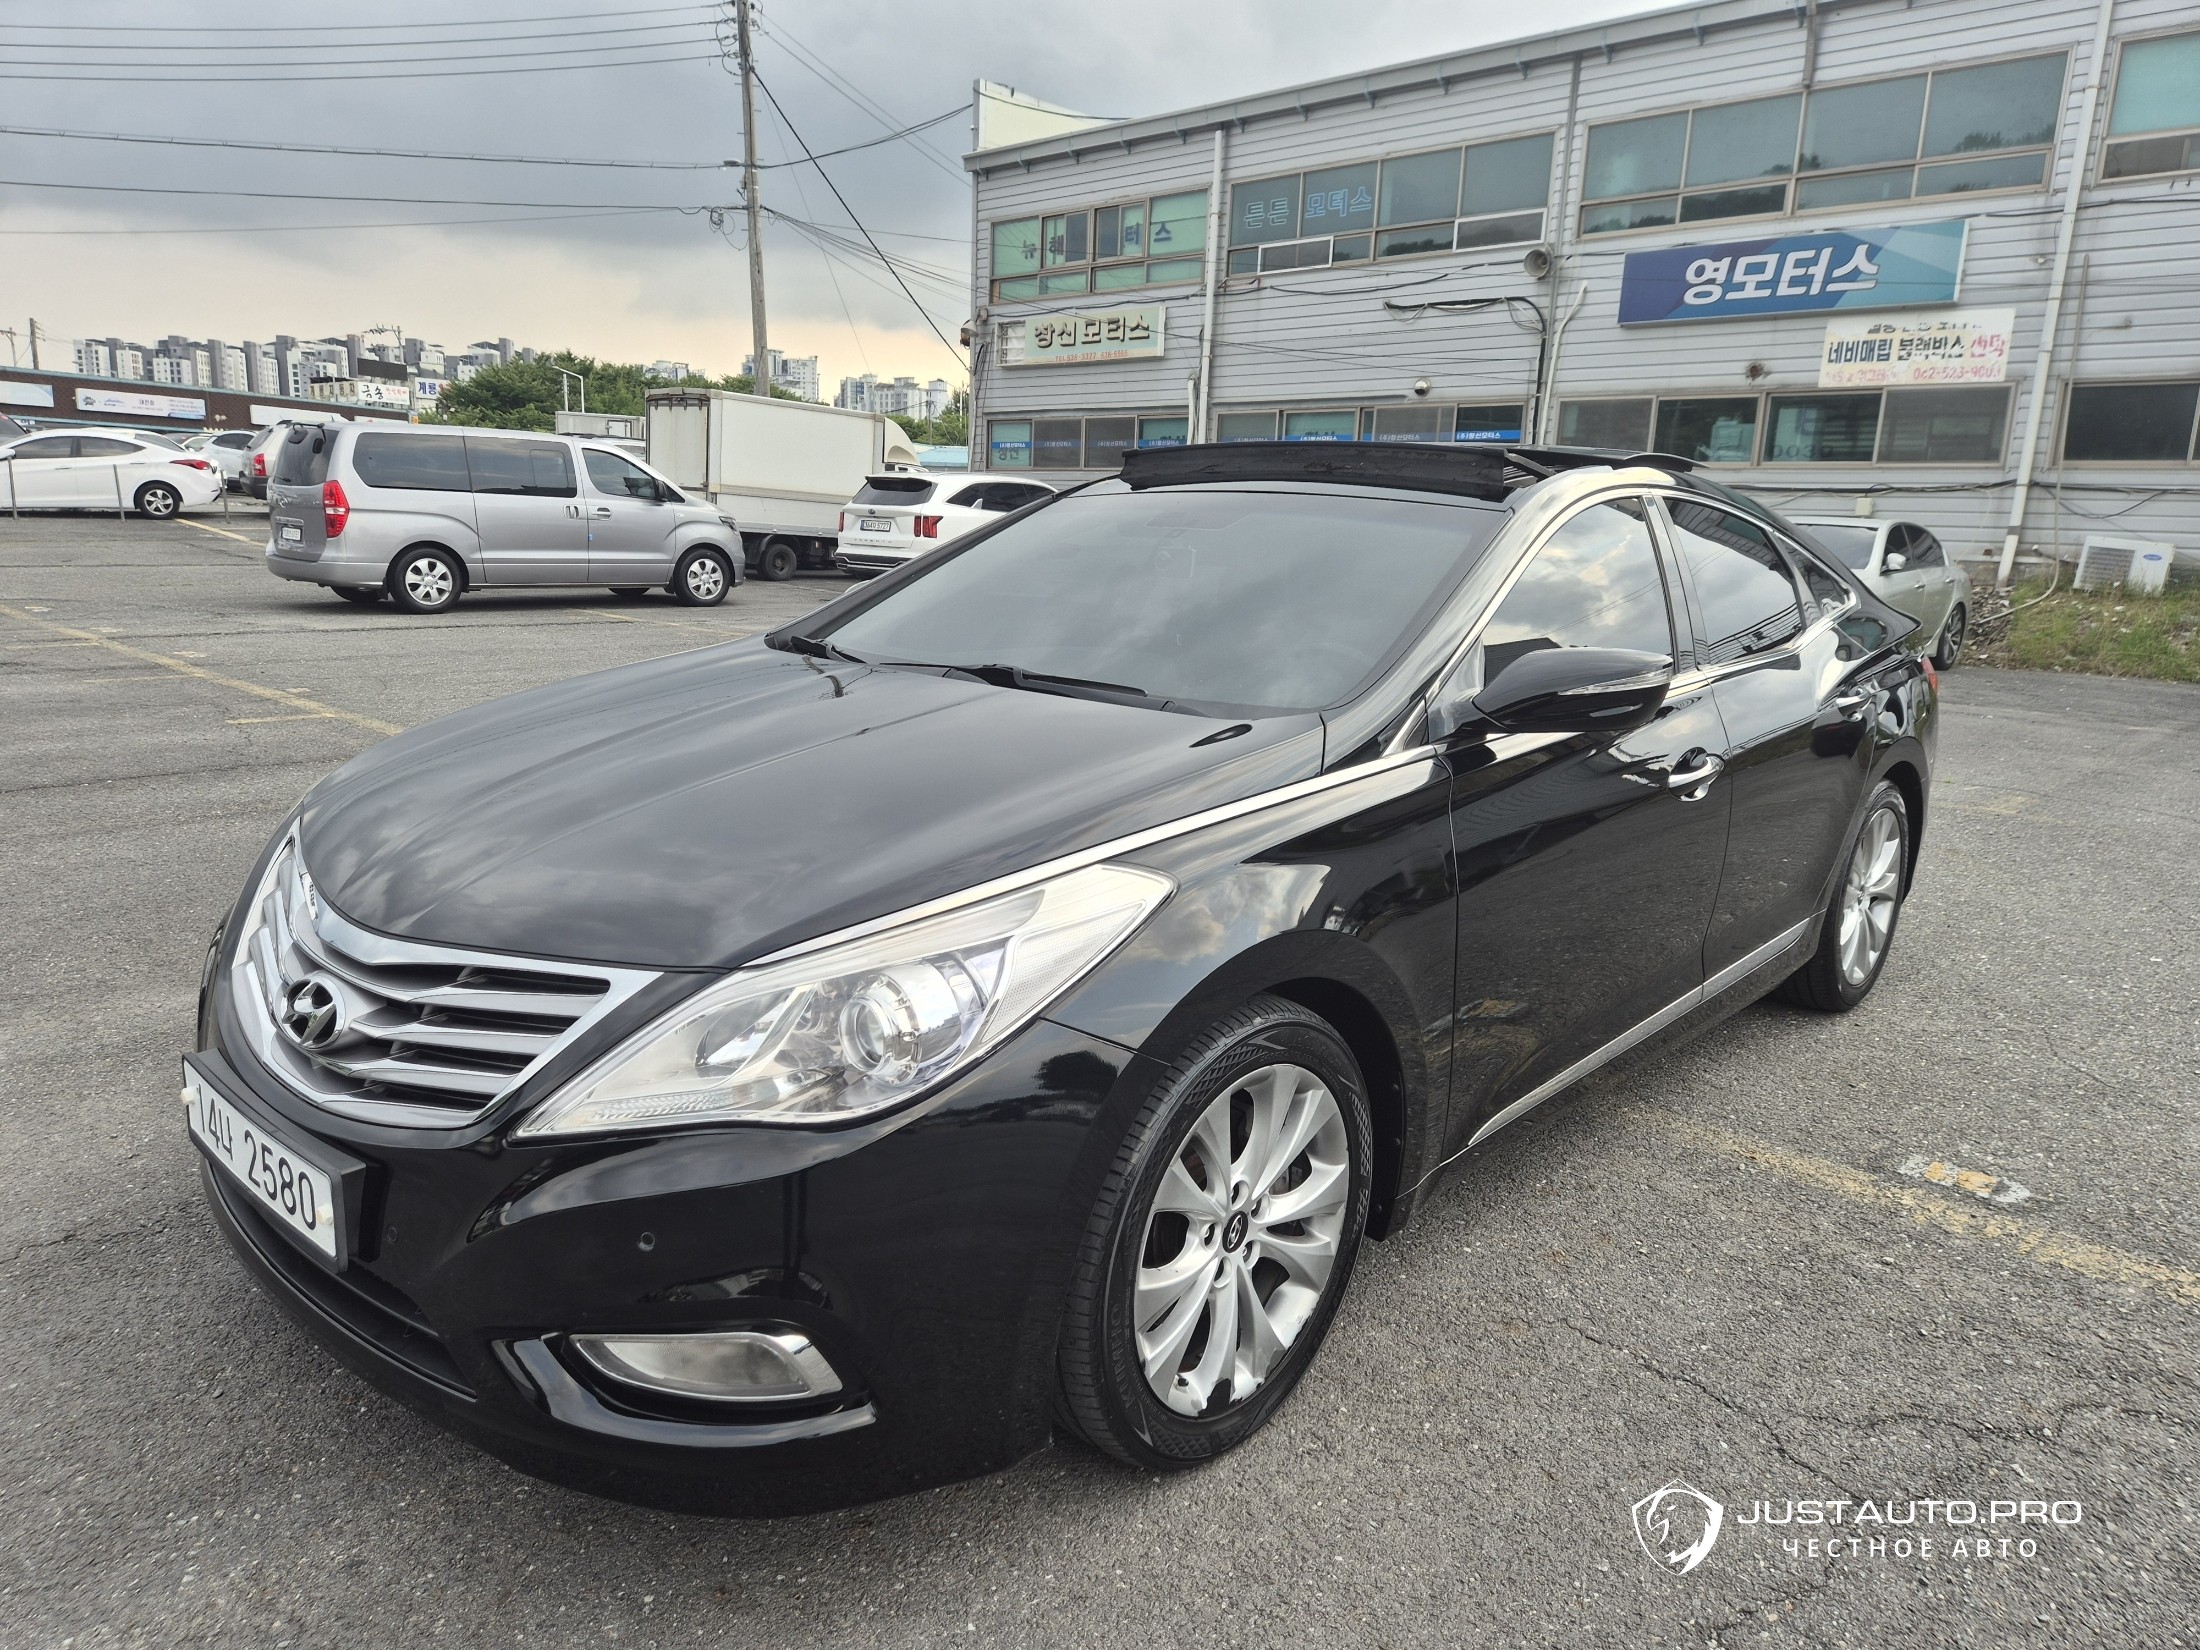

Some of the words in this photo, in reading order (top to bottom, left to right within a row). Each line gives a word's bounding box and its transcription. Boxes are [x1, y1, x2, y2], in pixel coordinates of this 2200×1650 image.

[1244, 197, 1289, 229] 튼튼
[1305, 186, 1372, 218] 모터스
[1683, 243, 1880, 305] 영모터스
[1035, 314, 1150, 348] 창신모터스
[1827, 338, 1894, 364] 네비매립
[418, 381, 437, 396] 계룡
[244, 1129, 317, 1231] 2580
